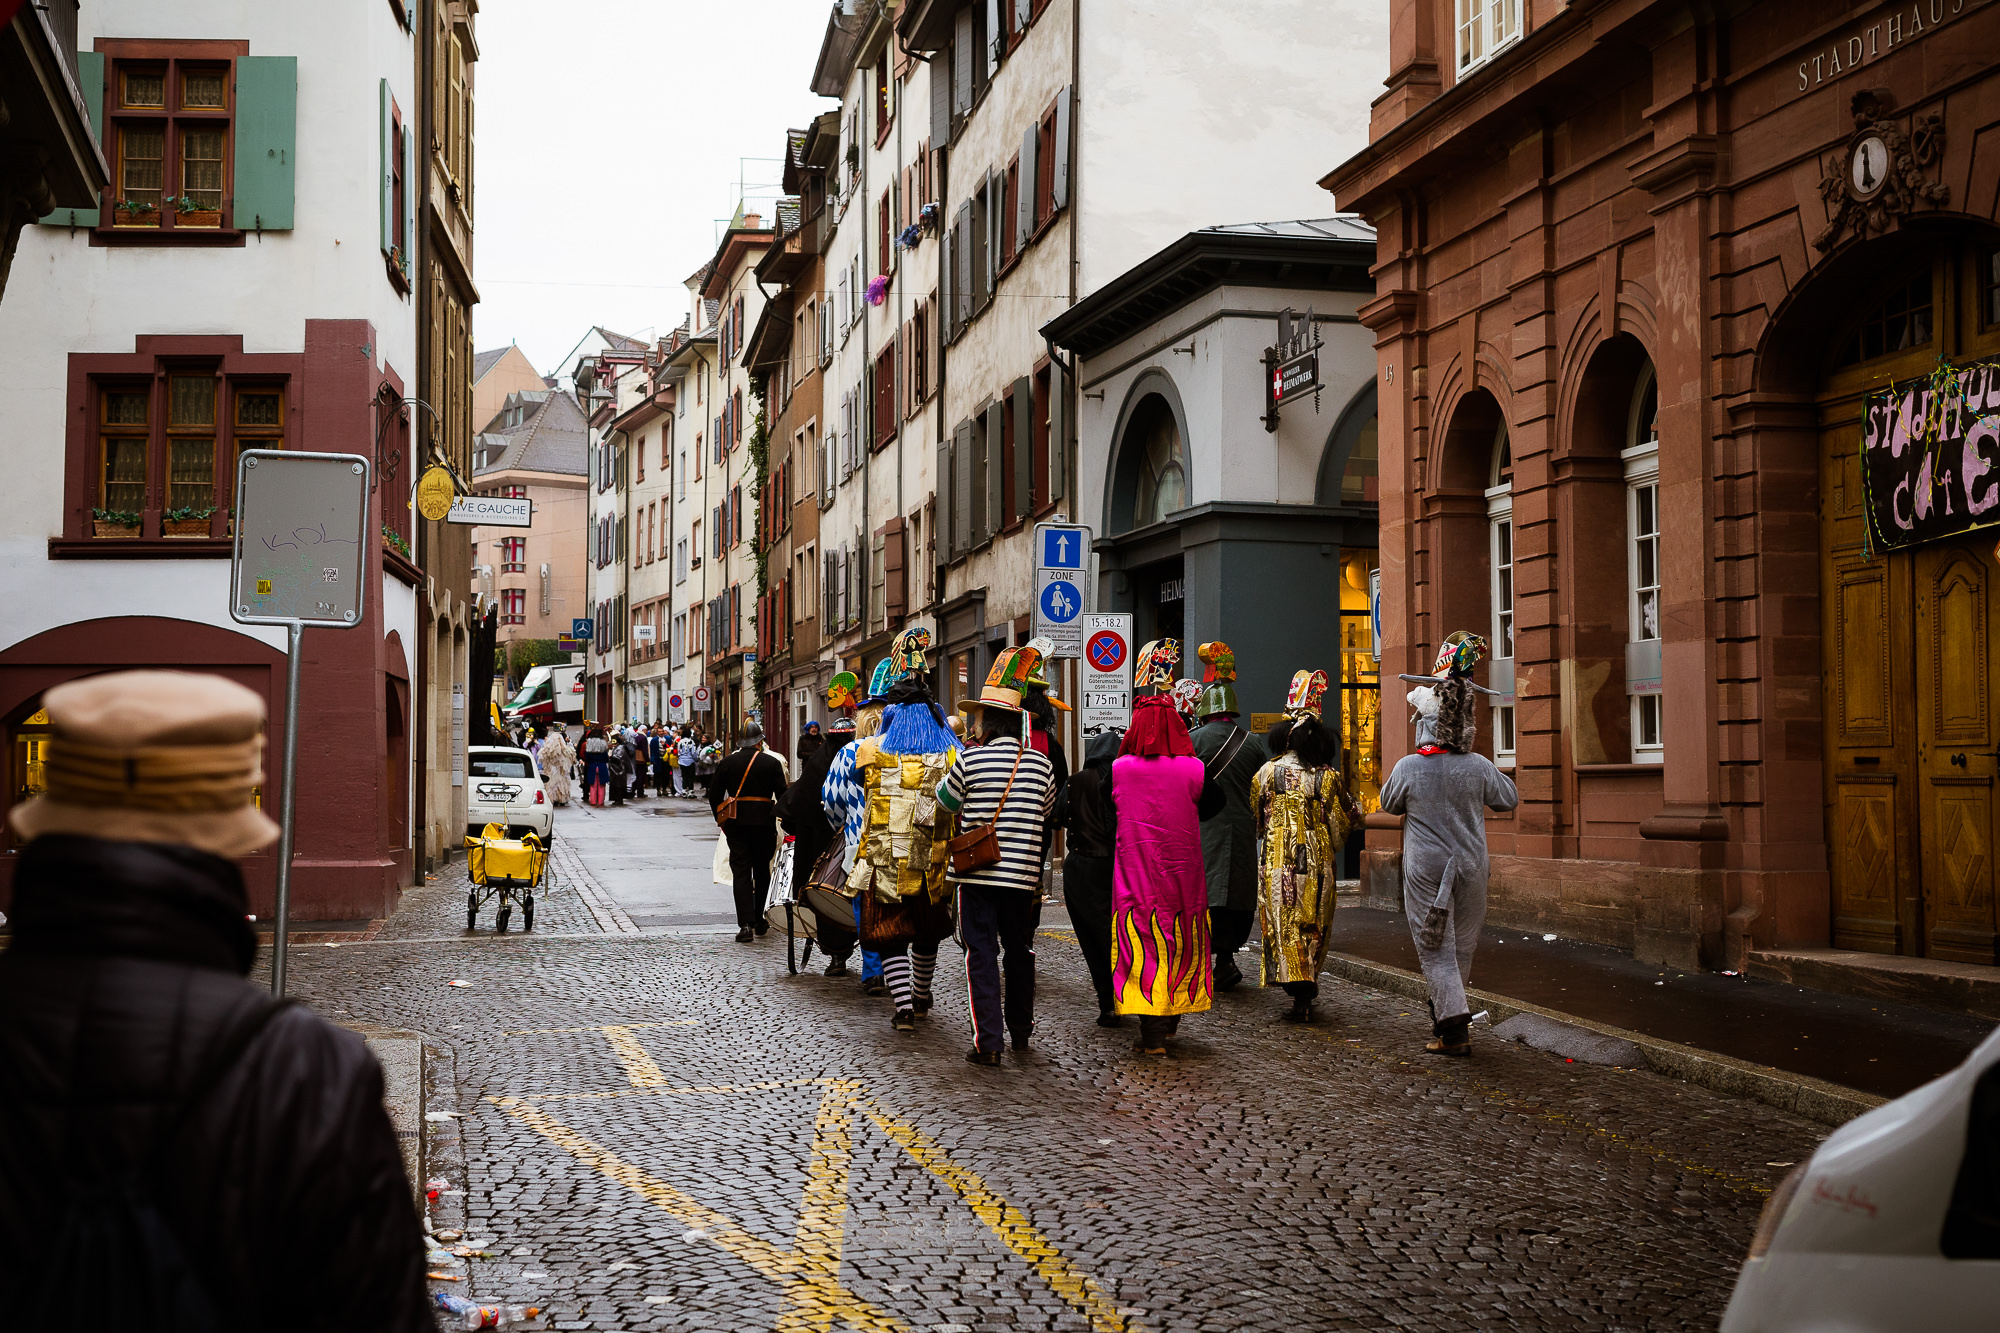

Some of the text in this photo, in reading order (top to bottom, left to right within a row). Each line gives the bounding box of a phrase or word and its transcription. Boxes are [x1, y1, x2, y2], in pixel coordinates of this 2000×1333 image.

[1798, 0, 1964, 91] STADTHAUS
[1283, 369, 1313, 391] HEIMATWERK
[1385, 363, 1394, 386] 13
[450, 502, 526, 515] RIVE GAUCHE
[1050, 571, 1074, 581] ZONE
